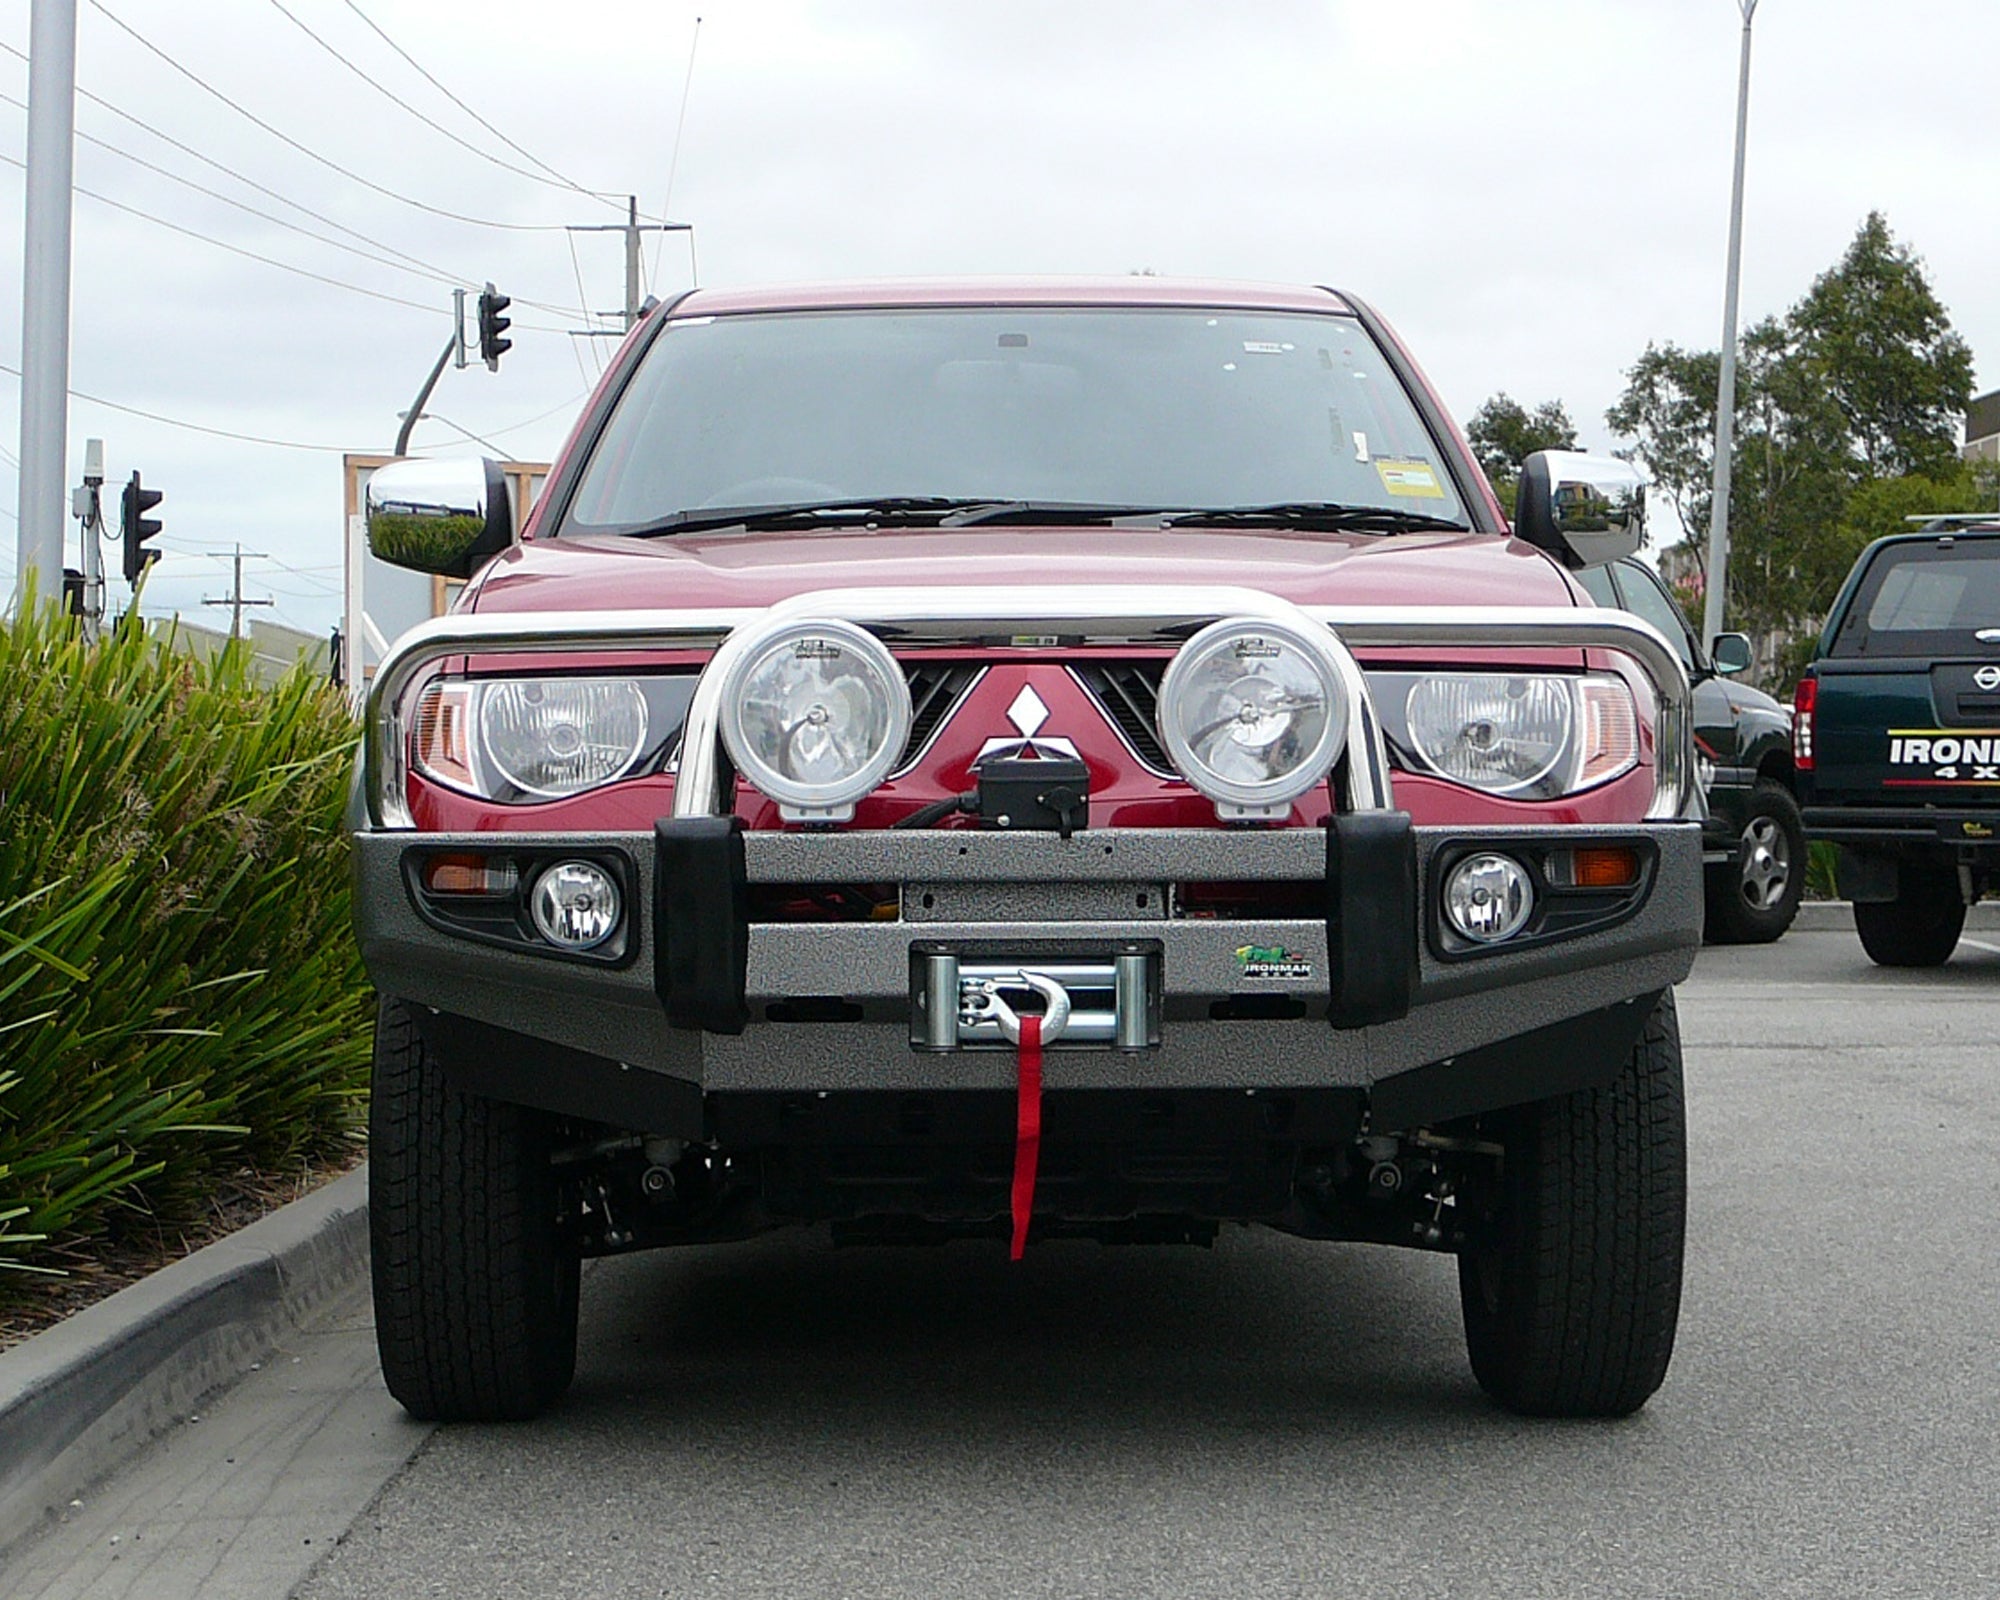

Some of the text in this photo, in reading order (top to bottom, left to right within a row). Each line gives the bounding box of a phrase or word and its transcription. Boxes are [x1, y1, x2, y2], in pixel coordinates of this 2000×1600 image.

[1890, 738, 2000, 764] IRON
[1934, 766, 1958, 778] 4
[1245, 963, 1311, 973] IRONMAN
